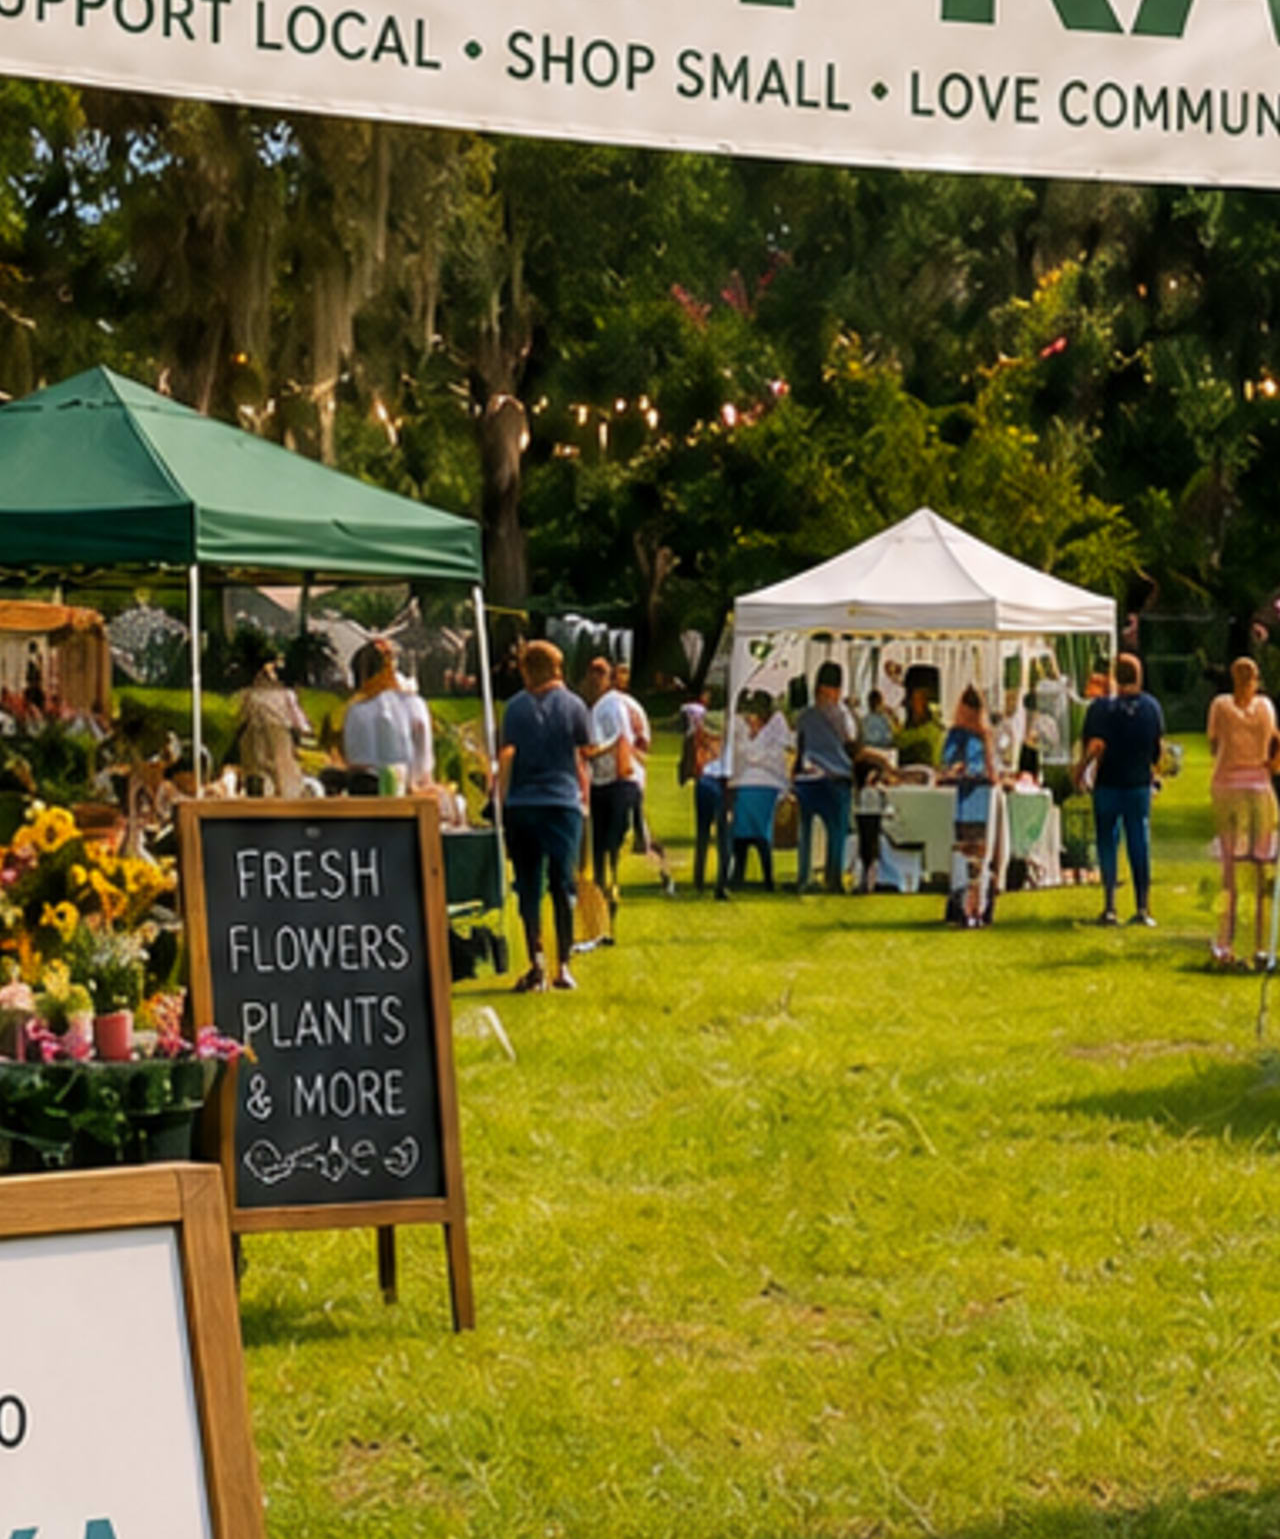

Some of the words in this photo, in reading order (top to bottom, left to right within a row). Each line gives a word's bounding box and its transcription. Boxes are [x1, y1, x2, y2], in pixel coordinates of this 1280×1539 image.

[257, 1, 440, 69] LOCAL
[508, 32, 654, 90] SHOP
[677, 50, 849, 110] SMALL
[912, 72, 1038, 123] LOVE
[237, 849, 378, 899] FRESH
[230, 925, 408, 971] FLOWERS
[243, 996, 404, 1048] PLANTS
[247, 1074, 271, 1119] &
[295, 1070, 405, 1116] MORE
